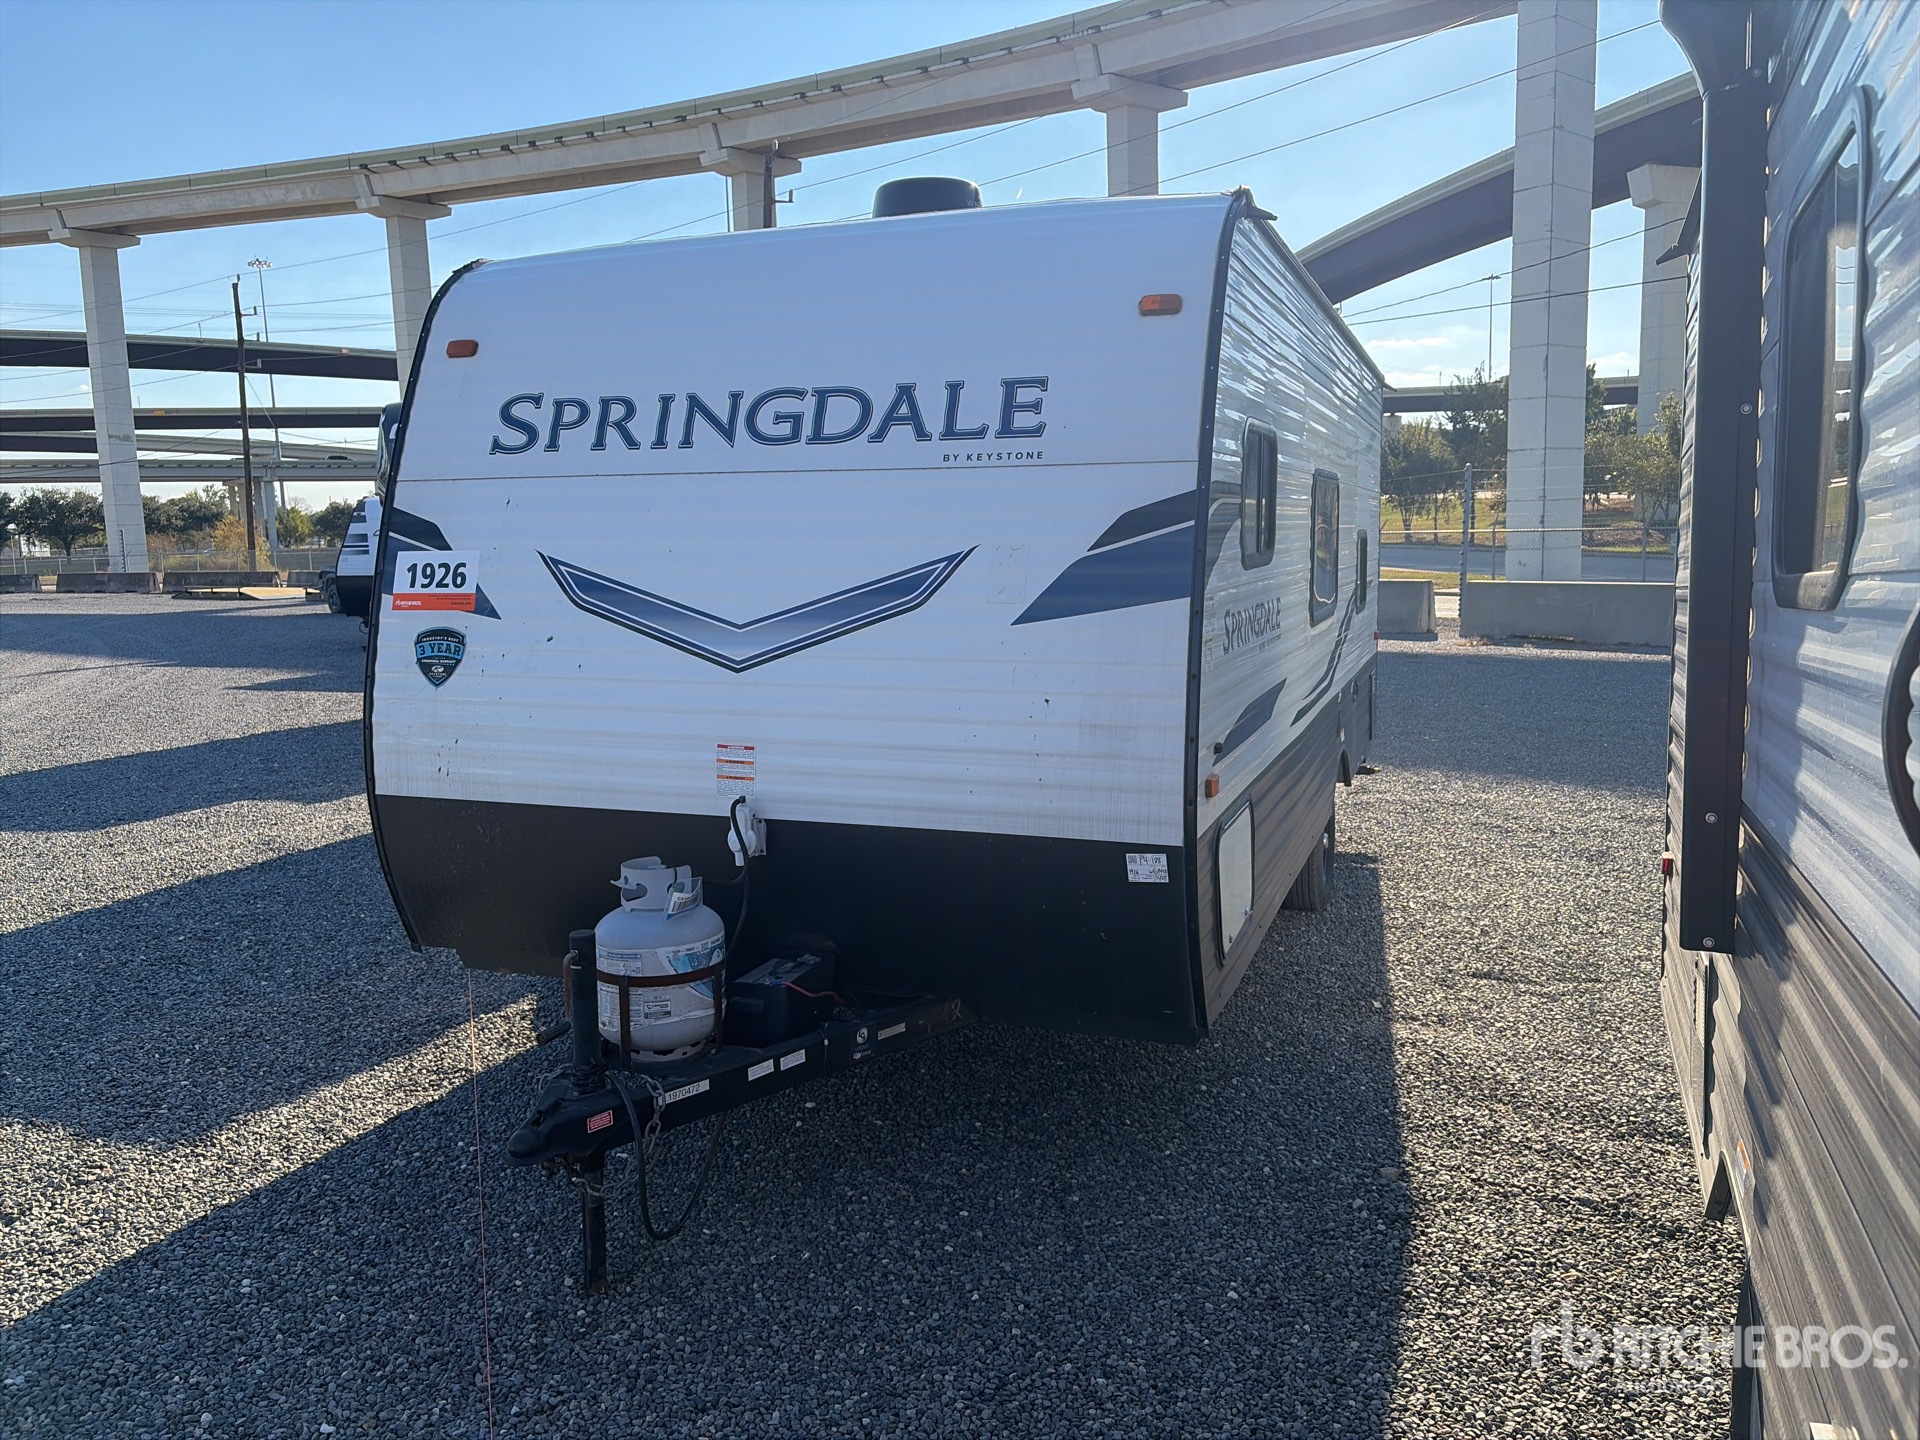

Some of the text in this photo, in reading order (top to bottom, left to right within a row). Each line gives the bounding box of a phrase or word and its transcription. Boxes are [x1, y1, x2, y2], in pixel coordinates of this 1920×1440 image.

[489, 376, 1050, 455] SPRINGDALE
[943, 451, 1043, 462] BY KEYSTONE
[406, 562, 467, 589] 1926
[1223, 596, 1281, 656] SPRINGDALE
[418, 642, 461, 657] 3 YEAR
[668, 1083, 701, 1101] 1970472
